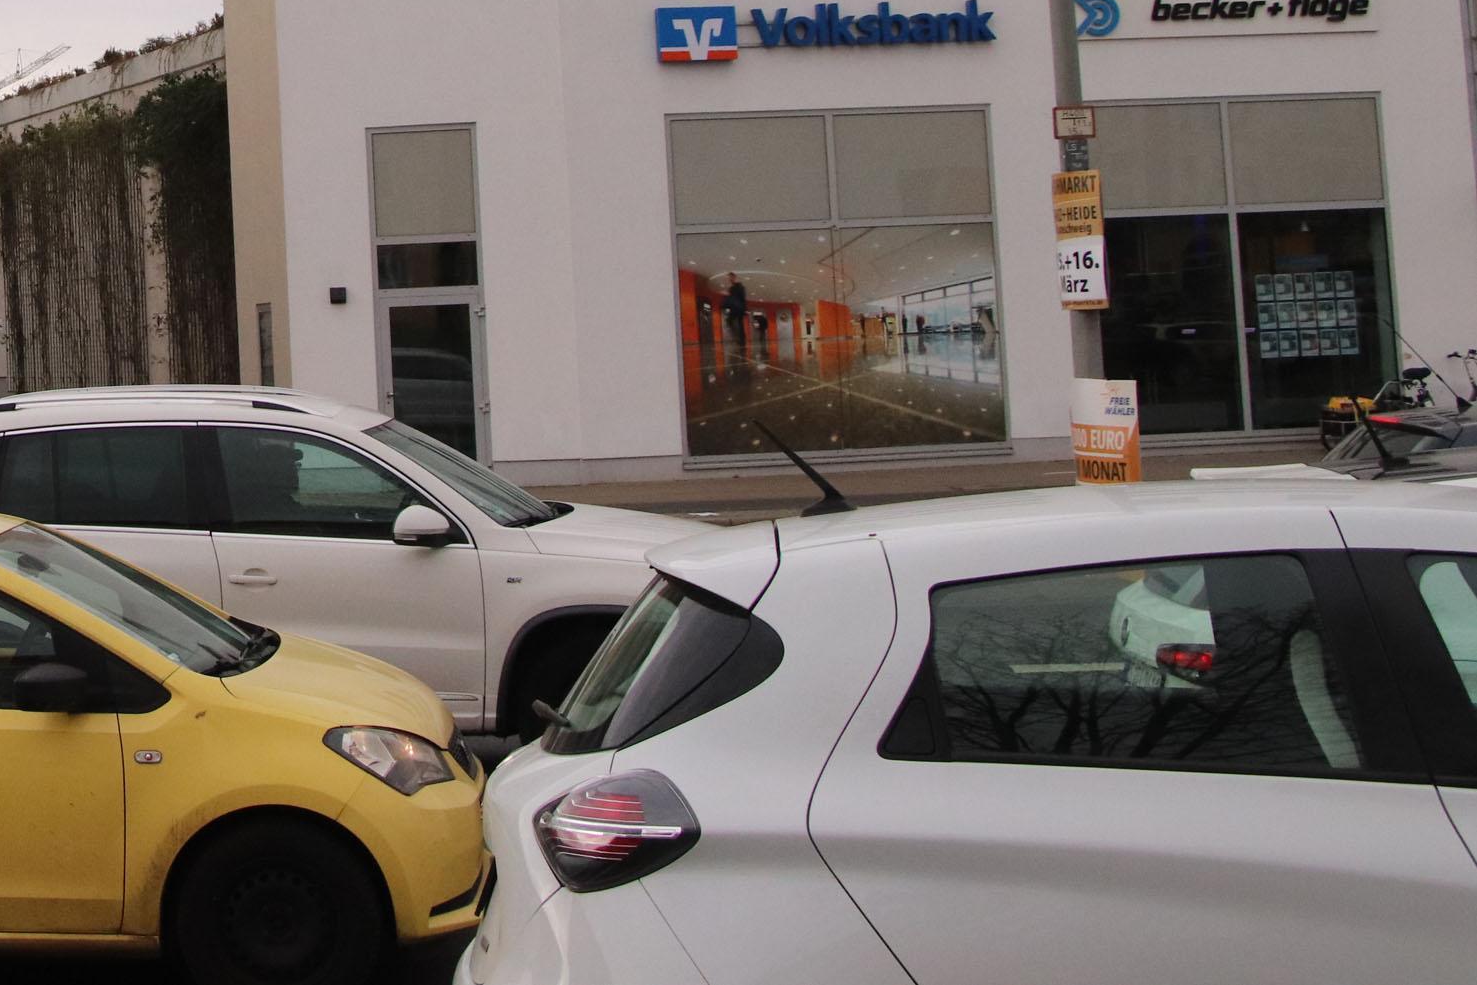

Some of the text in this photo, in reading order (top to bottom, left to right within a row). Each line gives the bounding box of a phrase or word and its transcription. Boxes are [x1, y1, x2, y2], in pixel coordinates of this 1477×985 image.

[750, 0, 997, 48] Volksbank
[1055, 175, 1097, 195] MARKT
[1104, 406, 1135, 416] WÄHLER
[1109, 397, 1131, 406] FREIE
[1090, 430, 1125, 450] EURO
[1081, 459, 1127, 481] MONAT
